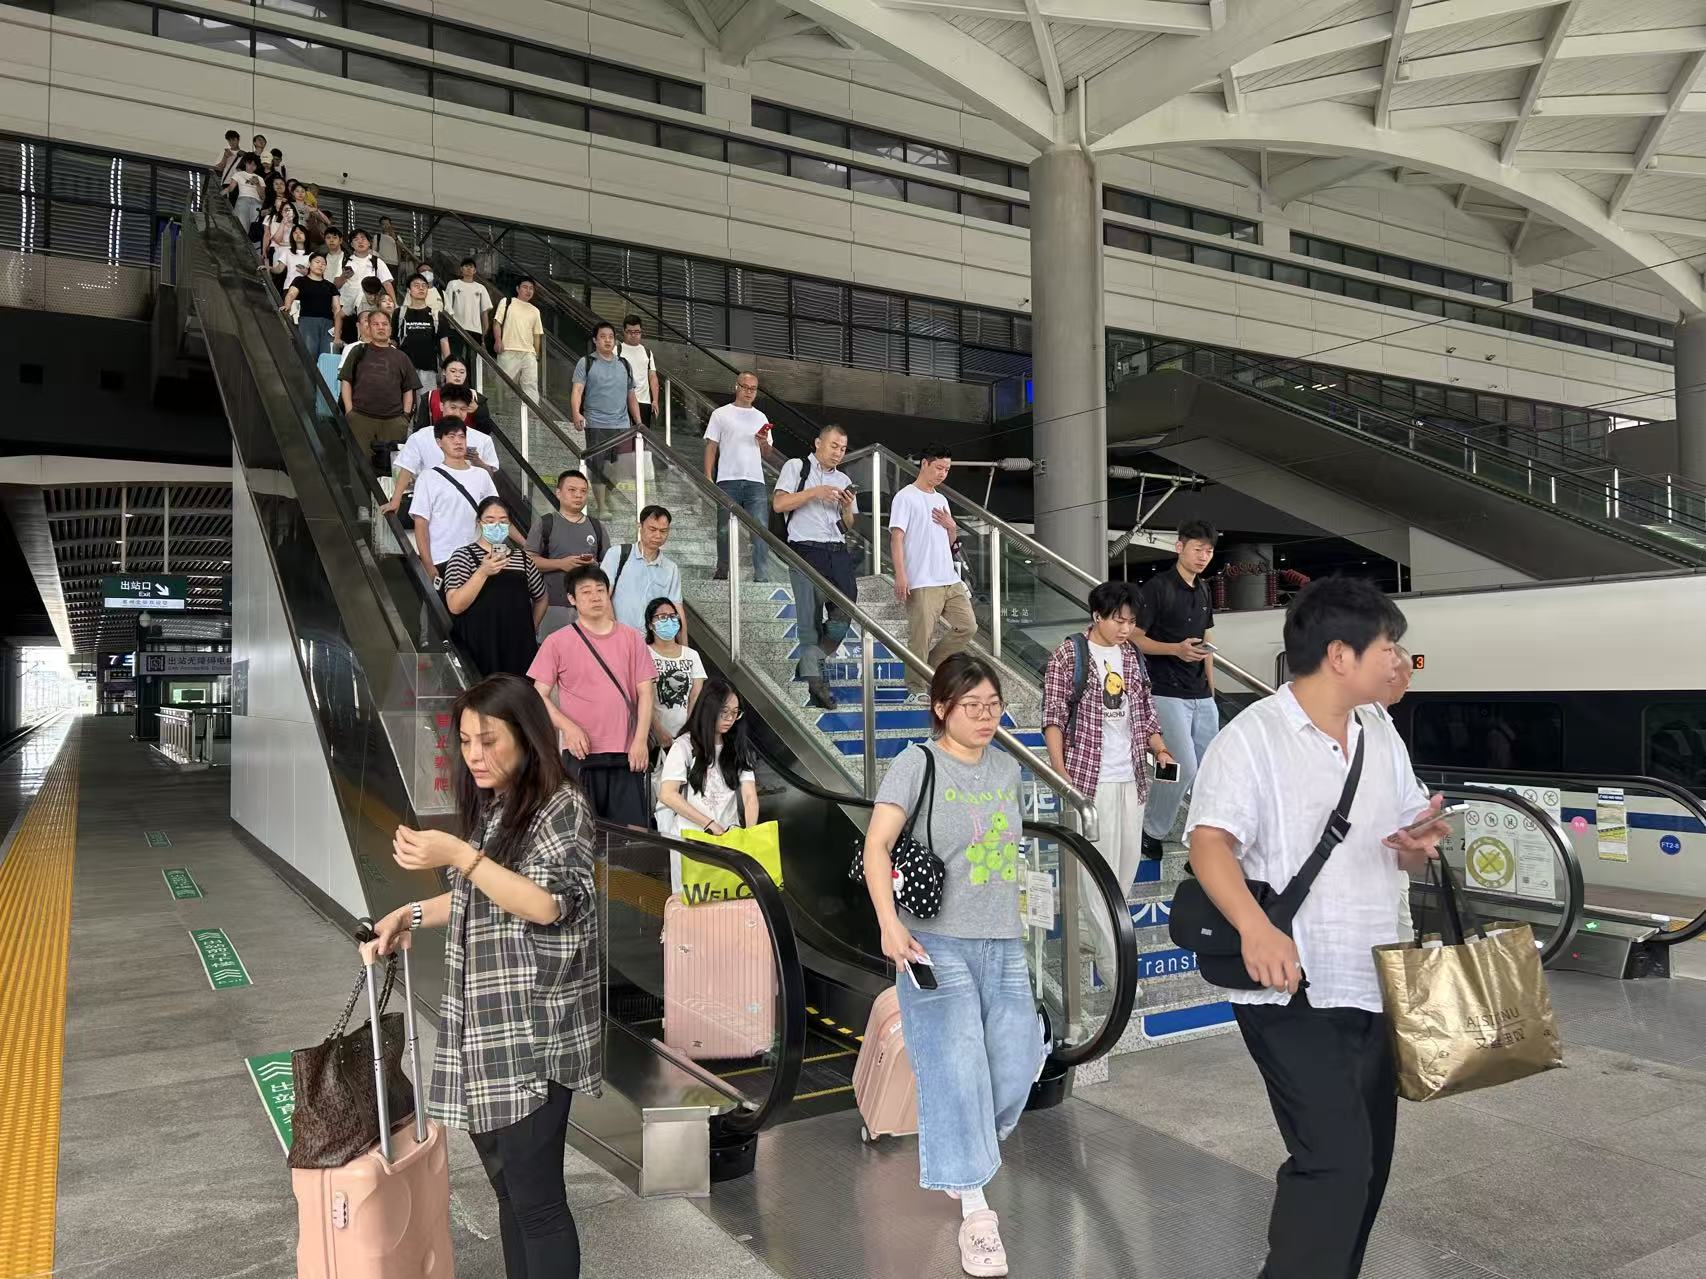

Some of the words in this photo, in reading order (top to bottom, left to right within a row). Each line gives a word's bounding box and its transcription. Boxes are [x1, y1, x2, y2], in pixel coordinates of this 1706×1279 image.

[120, 580, 151, 590] 出站口
[1416, 656, 1424, 669] 3
[683, 882, 752, 906] WELC
